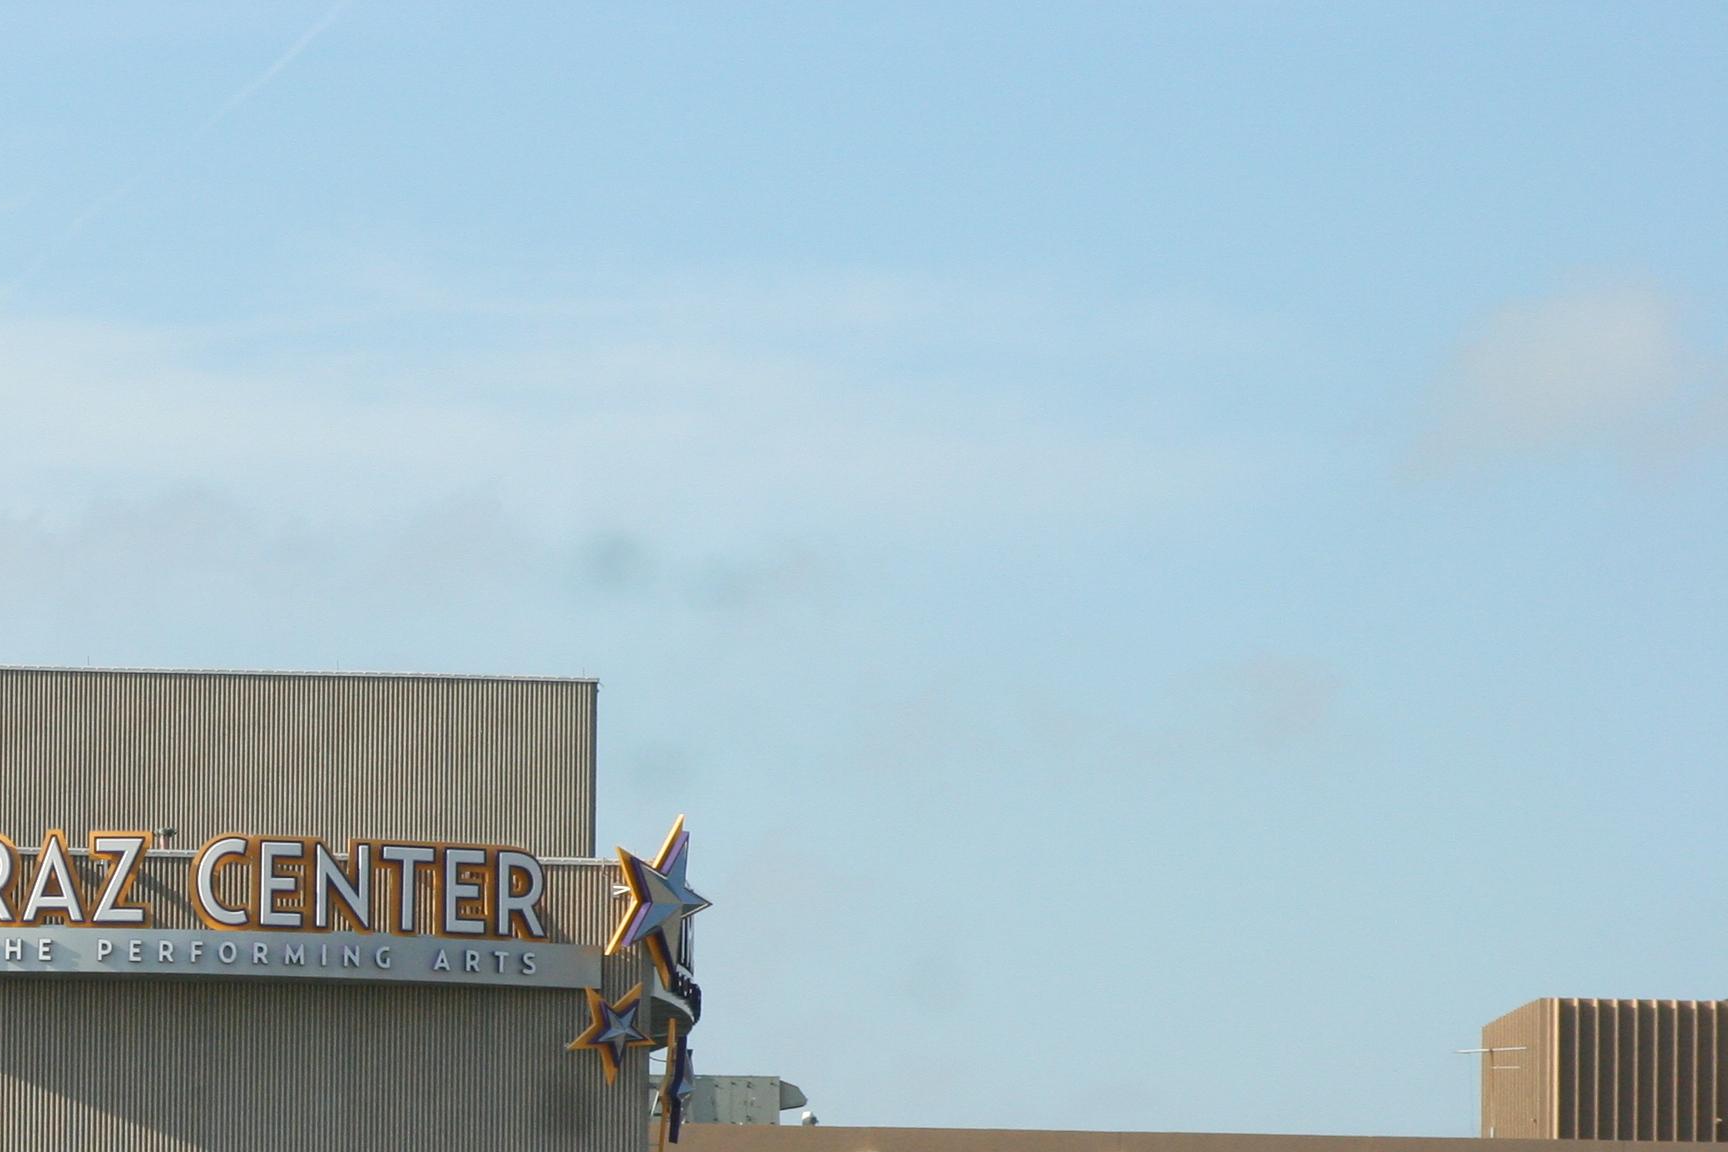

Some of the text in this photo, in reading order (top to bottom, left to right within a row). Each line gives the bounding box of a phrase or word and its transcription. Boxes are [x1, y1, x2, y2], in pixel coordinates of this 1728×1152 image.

[196, 837, 547, 939] CENTER
[96, 939, 391, 970] PERFORMING
[433, 948, 538, 976] ARTS
